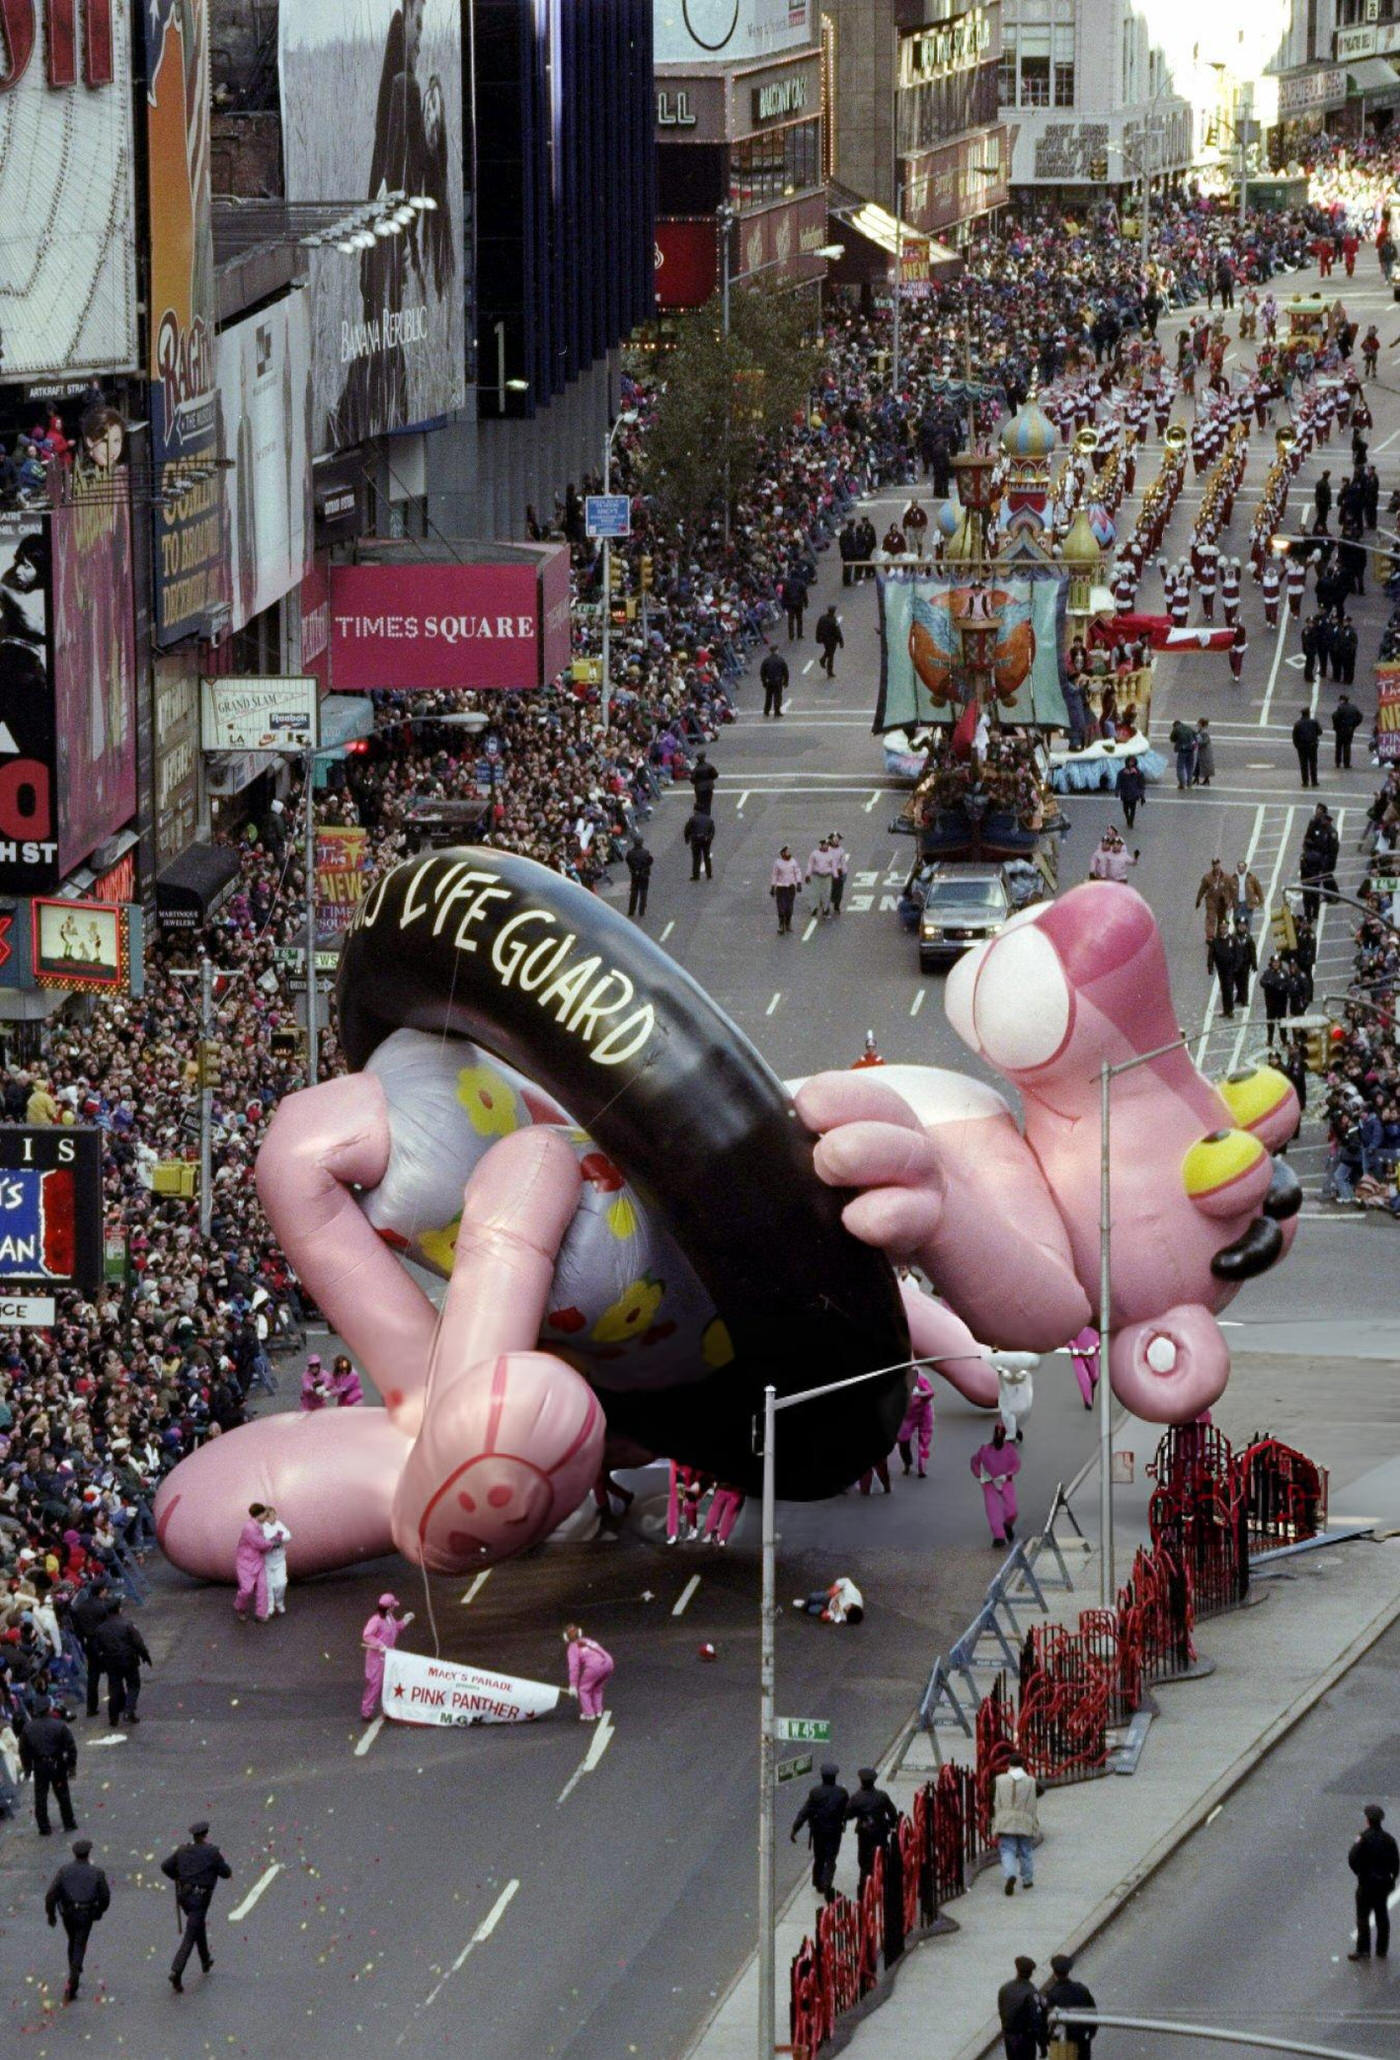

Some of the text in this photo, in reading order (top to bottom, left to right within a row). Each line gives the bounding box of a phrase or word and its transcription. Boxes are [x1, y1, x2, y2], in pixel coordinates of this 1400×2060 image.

[340, 306, 428, 363] BANANA REPUBLIC
[29, 385, 64, 398] ARTKRAFT
[161, 530, 180, 578] TO
[335, 616, 419, 639] TIMES
[424, 616, 534, 643] SQUARE
[217, 693, 277, 713] GRAND SLAM
[22, 842, 57, 863] ST
[319, 871, 363, 902] NEW
[319, 917, 350, 928] SQUA
[320, 906, 355, 918] TIME
[428, 1667, 513, 1692] MACY'S PARADE
[411, 1686, 520, 1720] PINK PANTHER
[791, 1722, 800, 1739] W
